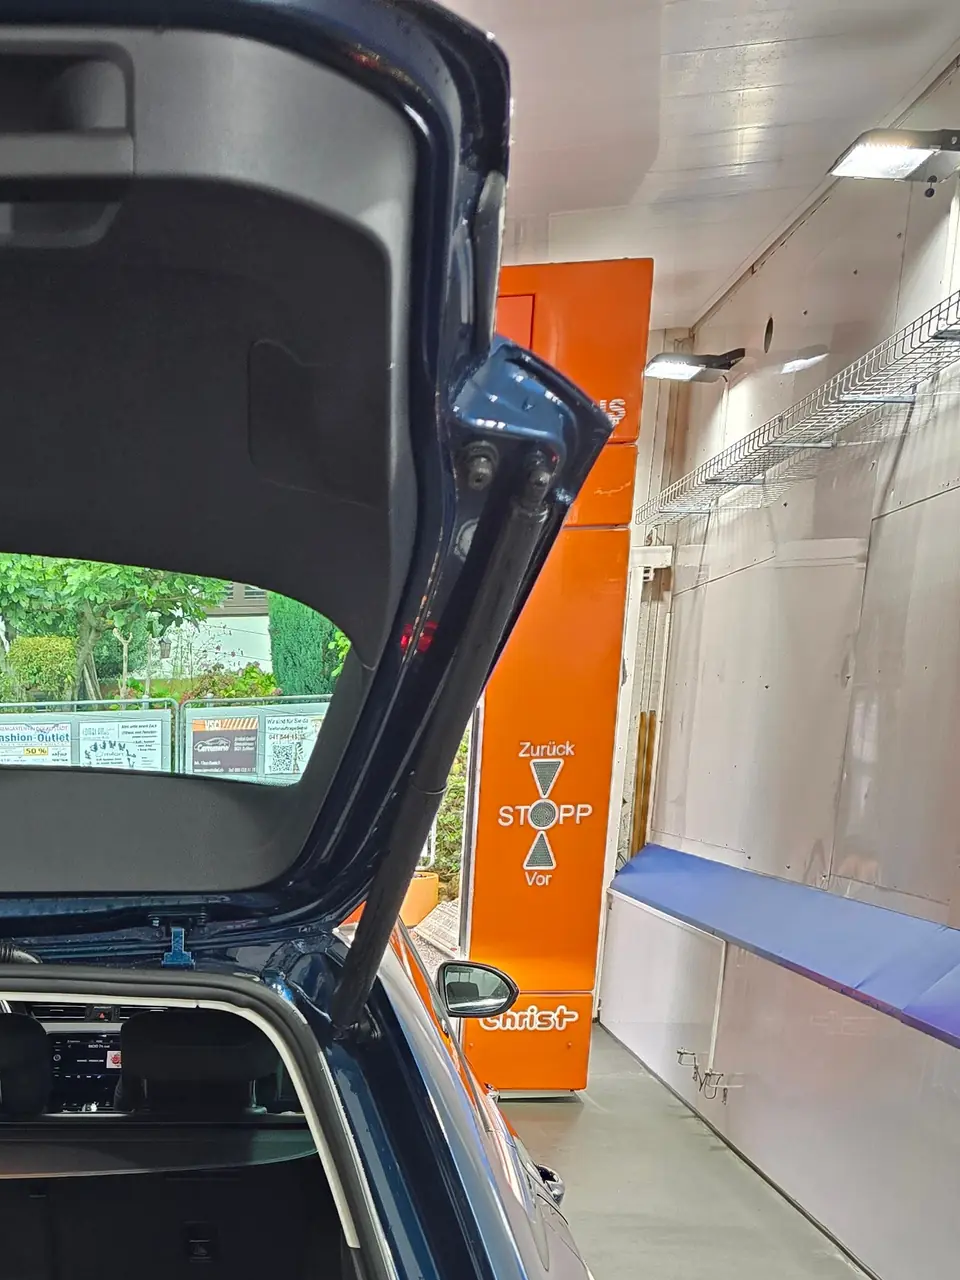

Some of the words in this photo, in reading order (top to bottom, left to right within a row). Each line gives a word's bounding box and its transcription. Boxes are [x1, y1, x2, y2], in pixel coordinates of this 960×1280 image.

[518, 741, 575, 758] Zurück
[498, 799, 593, 829] STOPP
[525, 871, 552, 887] Vor
[478, 1005, 579, 1031] Christ
